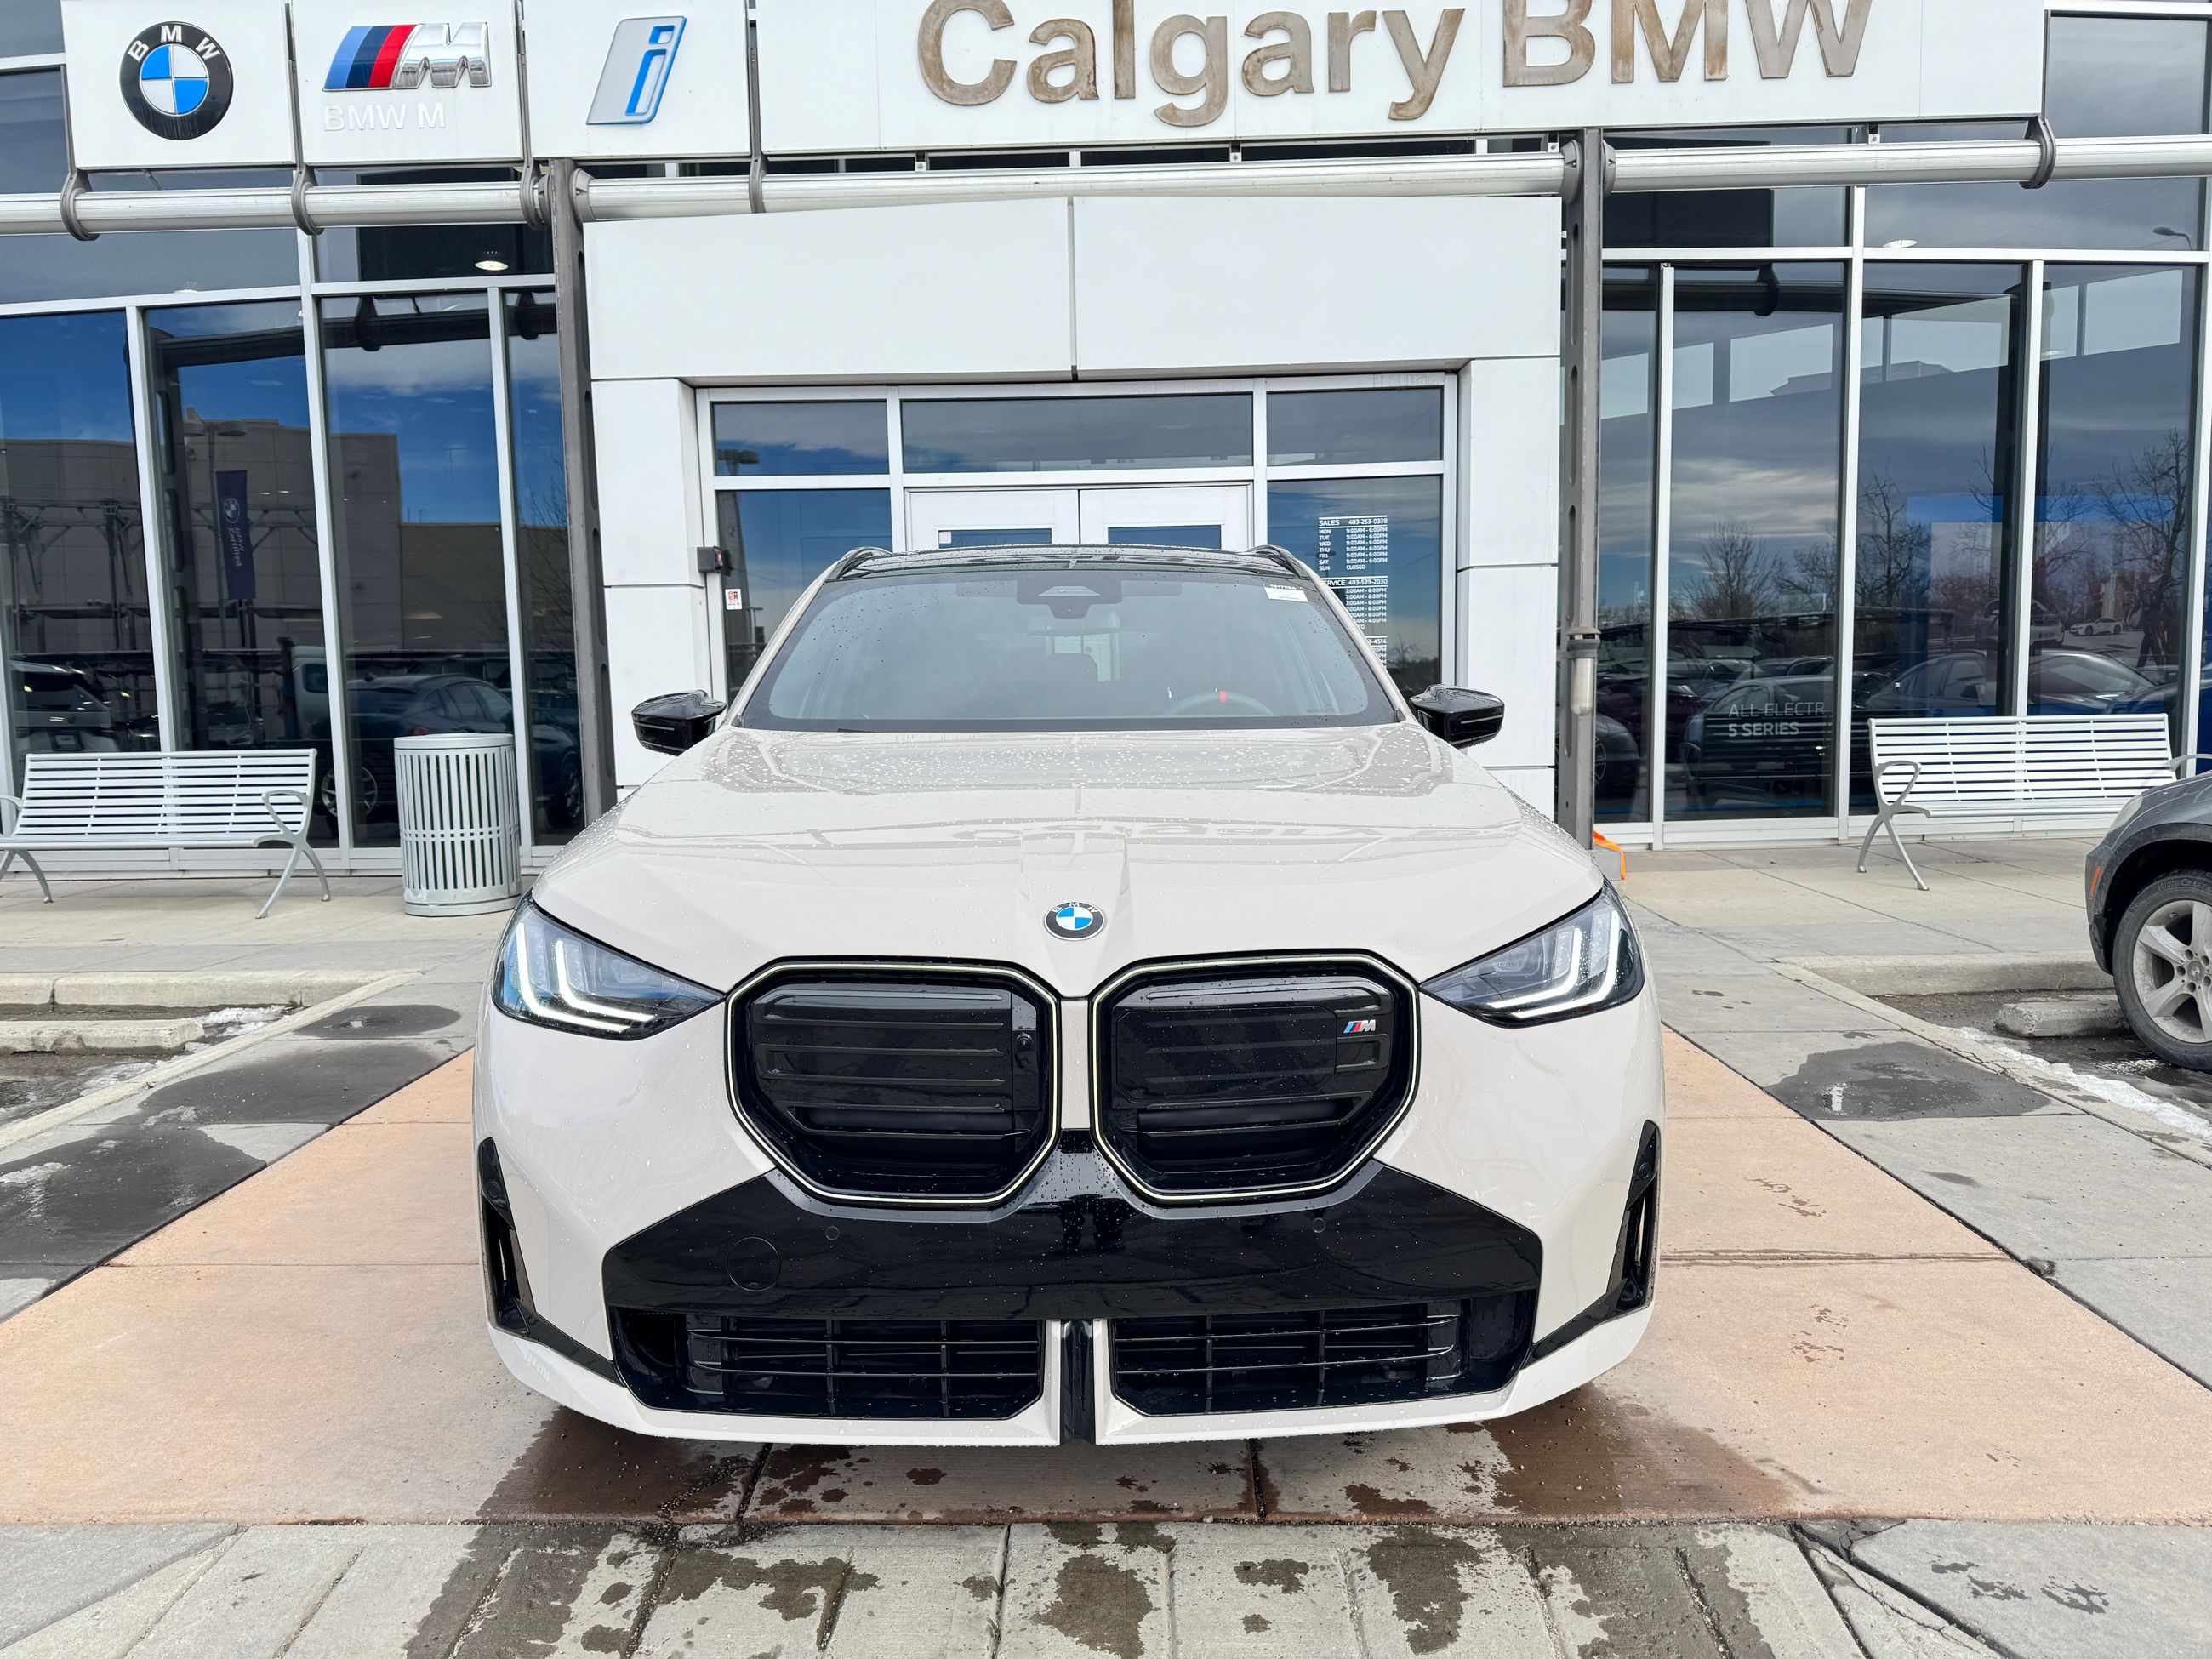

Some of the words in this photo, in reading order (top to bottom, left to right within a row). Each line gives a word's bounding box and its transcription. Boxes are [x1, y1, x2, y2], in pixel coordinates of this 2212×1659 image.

[127, 24, 221, 62] BMW
[917, 0, 1466, 128] Calgary
[1502, 0, 1872, 87] BMW
[323, 102, 408, 131] BMW
[417, 101, 447, 129] M
[1728, 724, 1737, 737] 5
[1742, 722, 1799, 736] SERIES
[1052, 901, 1099, 913] BMW
